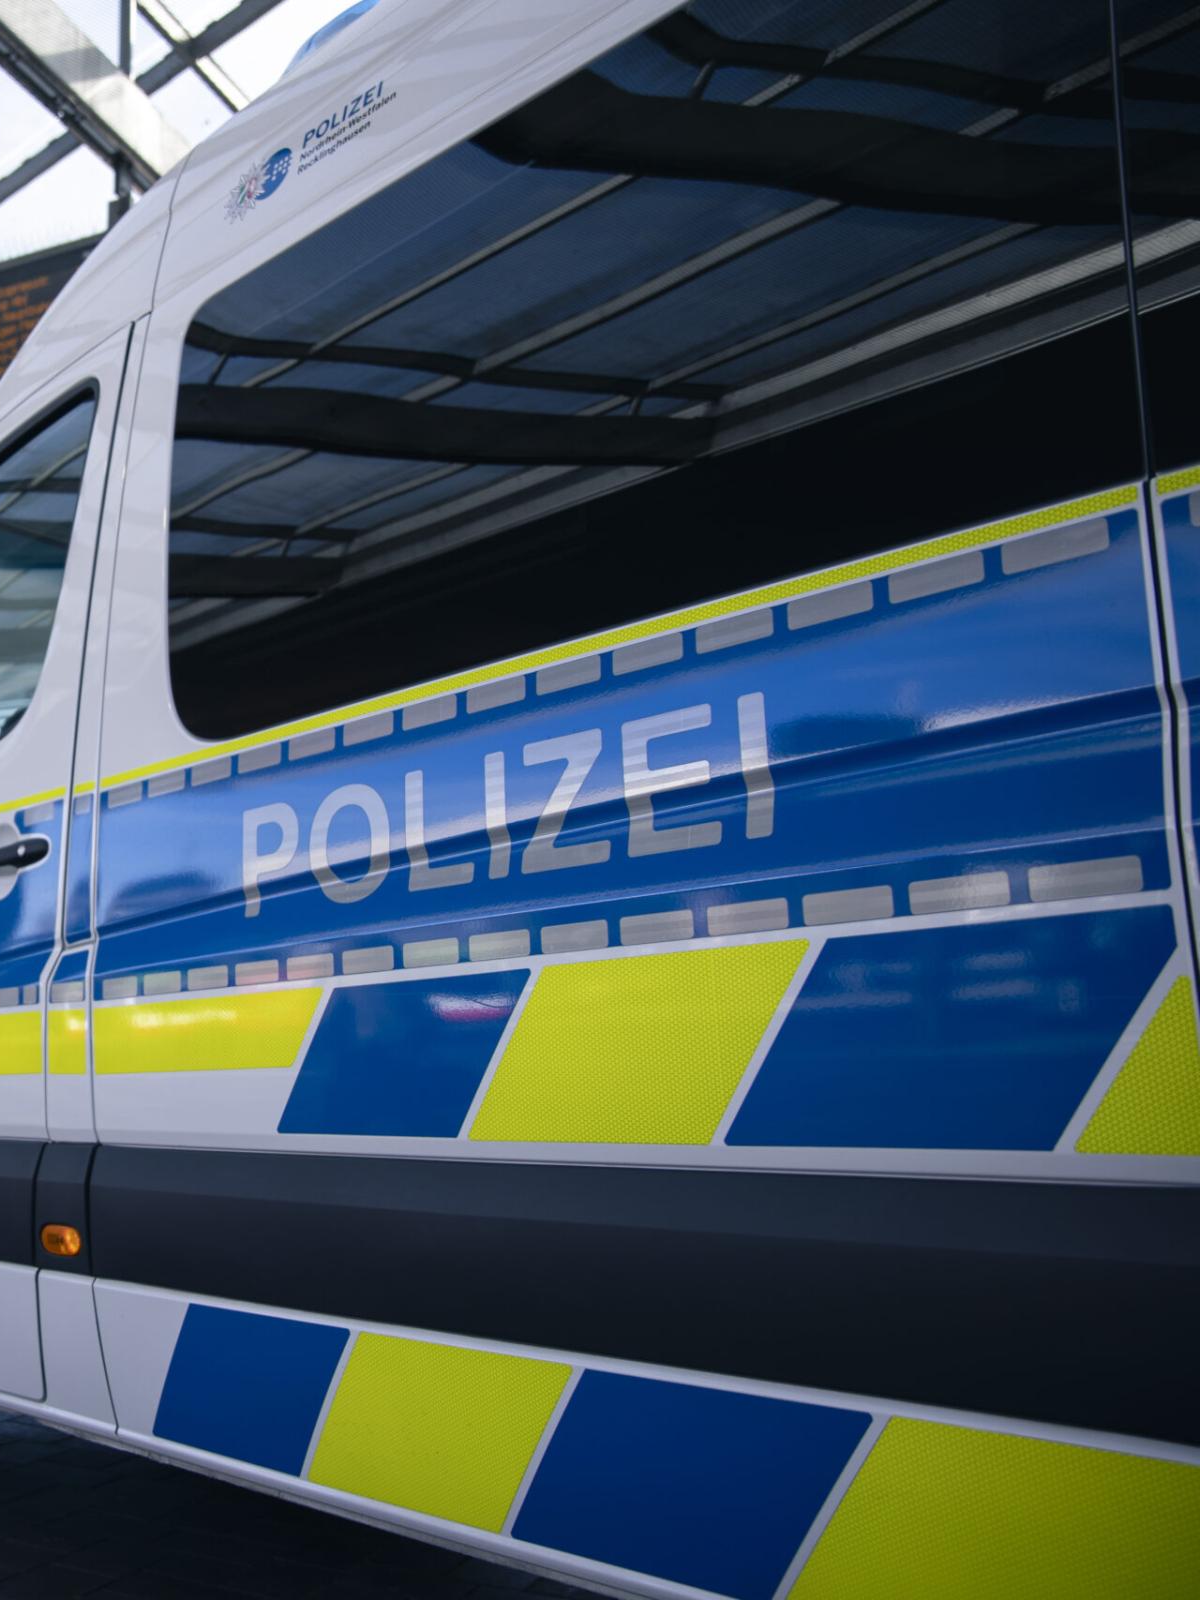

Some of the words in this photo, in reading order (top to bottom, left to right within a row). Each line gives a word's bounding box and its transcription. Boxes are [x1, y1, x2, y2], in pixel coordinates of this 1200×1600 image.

[297, 120, 371, 175] Recklinghausen
[300, 91, 397, 162] Nordrhein-Westfalen
[302, 80, 383, 149] POLIZEI
[241, 691, 776, 918] POLIZEI
